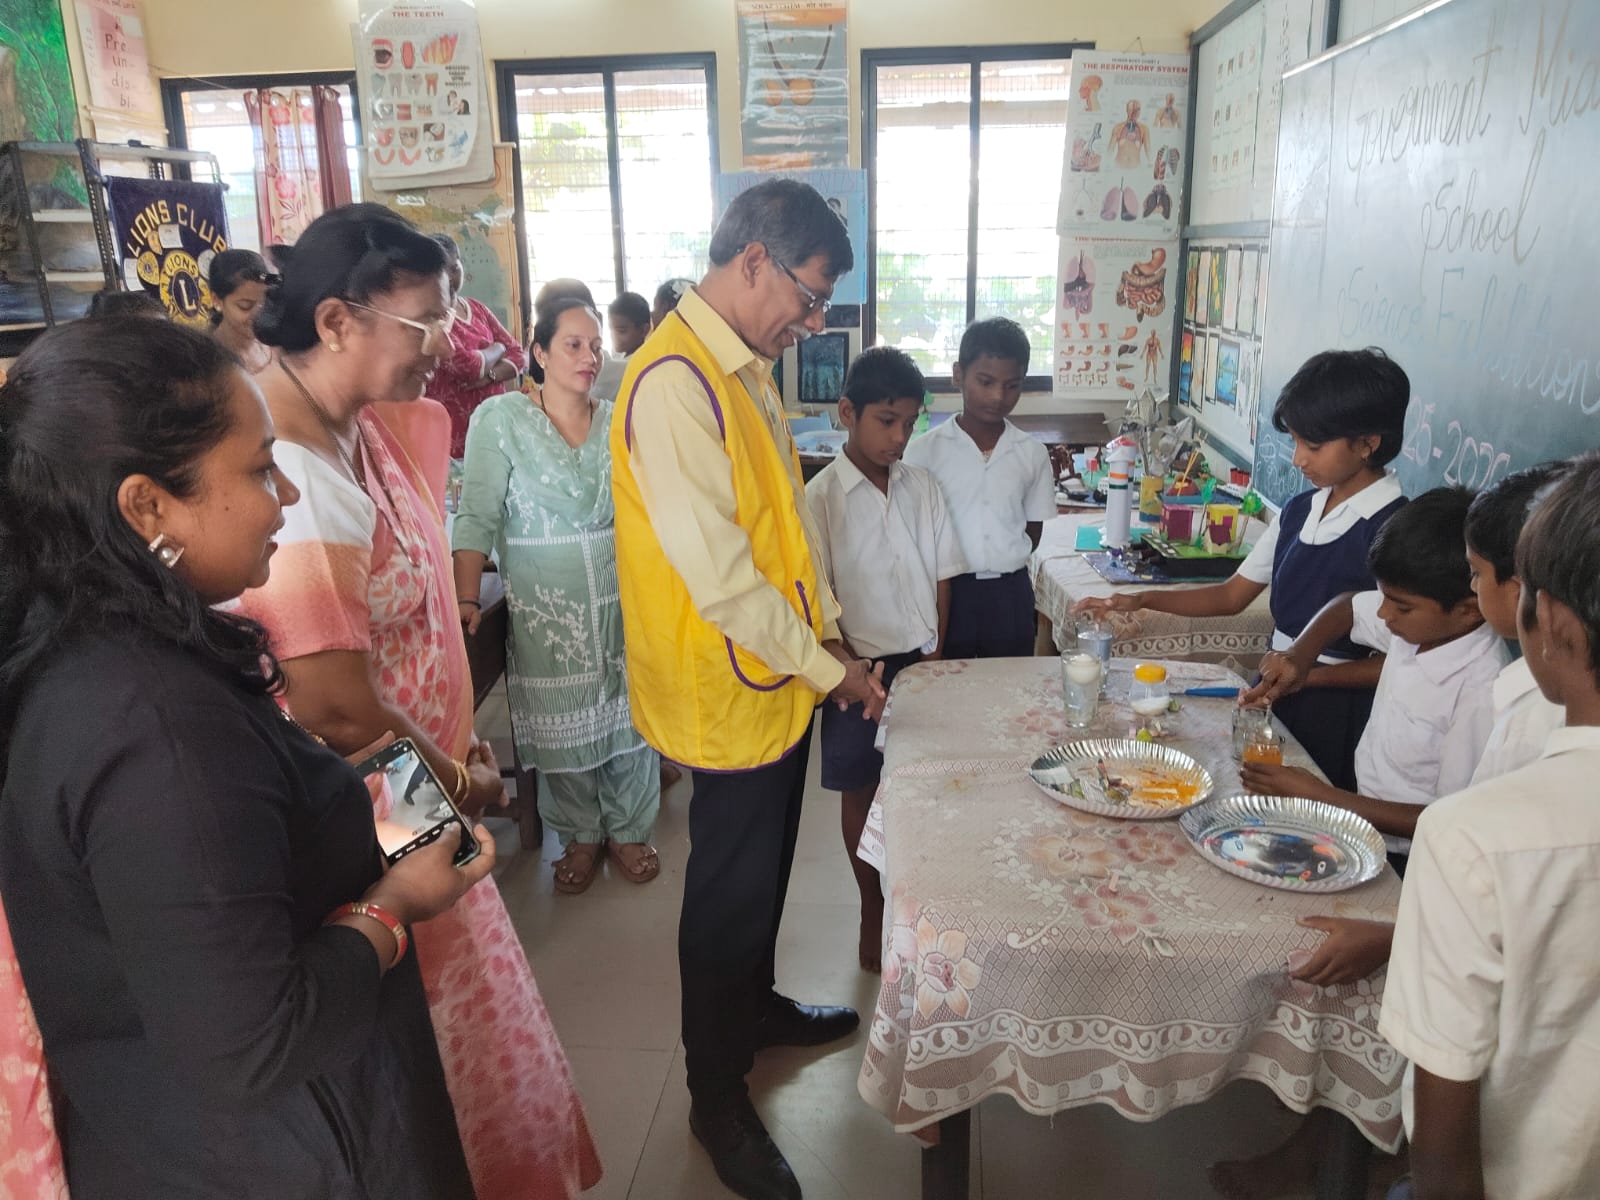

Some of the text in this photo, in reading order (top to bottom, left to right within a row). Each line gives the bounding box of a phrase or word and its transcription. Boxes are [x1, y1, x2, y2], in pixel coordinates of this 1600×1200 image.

[1100, 63, 1154, 72] RESPIRATORY
[127, 200, 227, 258] LIONS CLUB
[166, 255, 199, 275] LIONS
[179, 279, 197, 311] L
